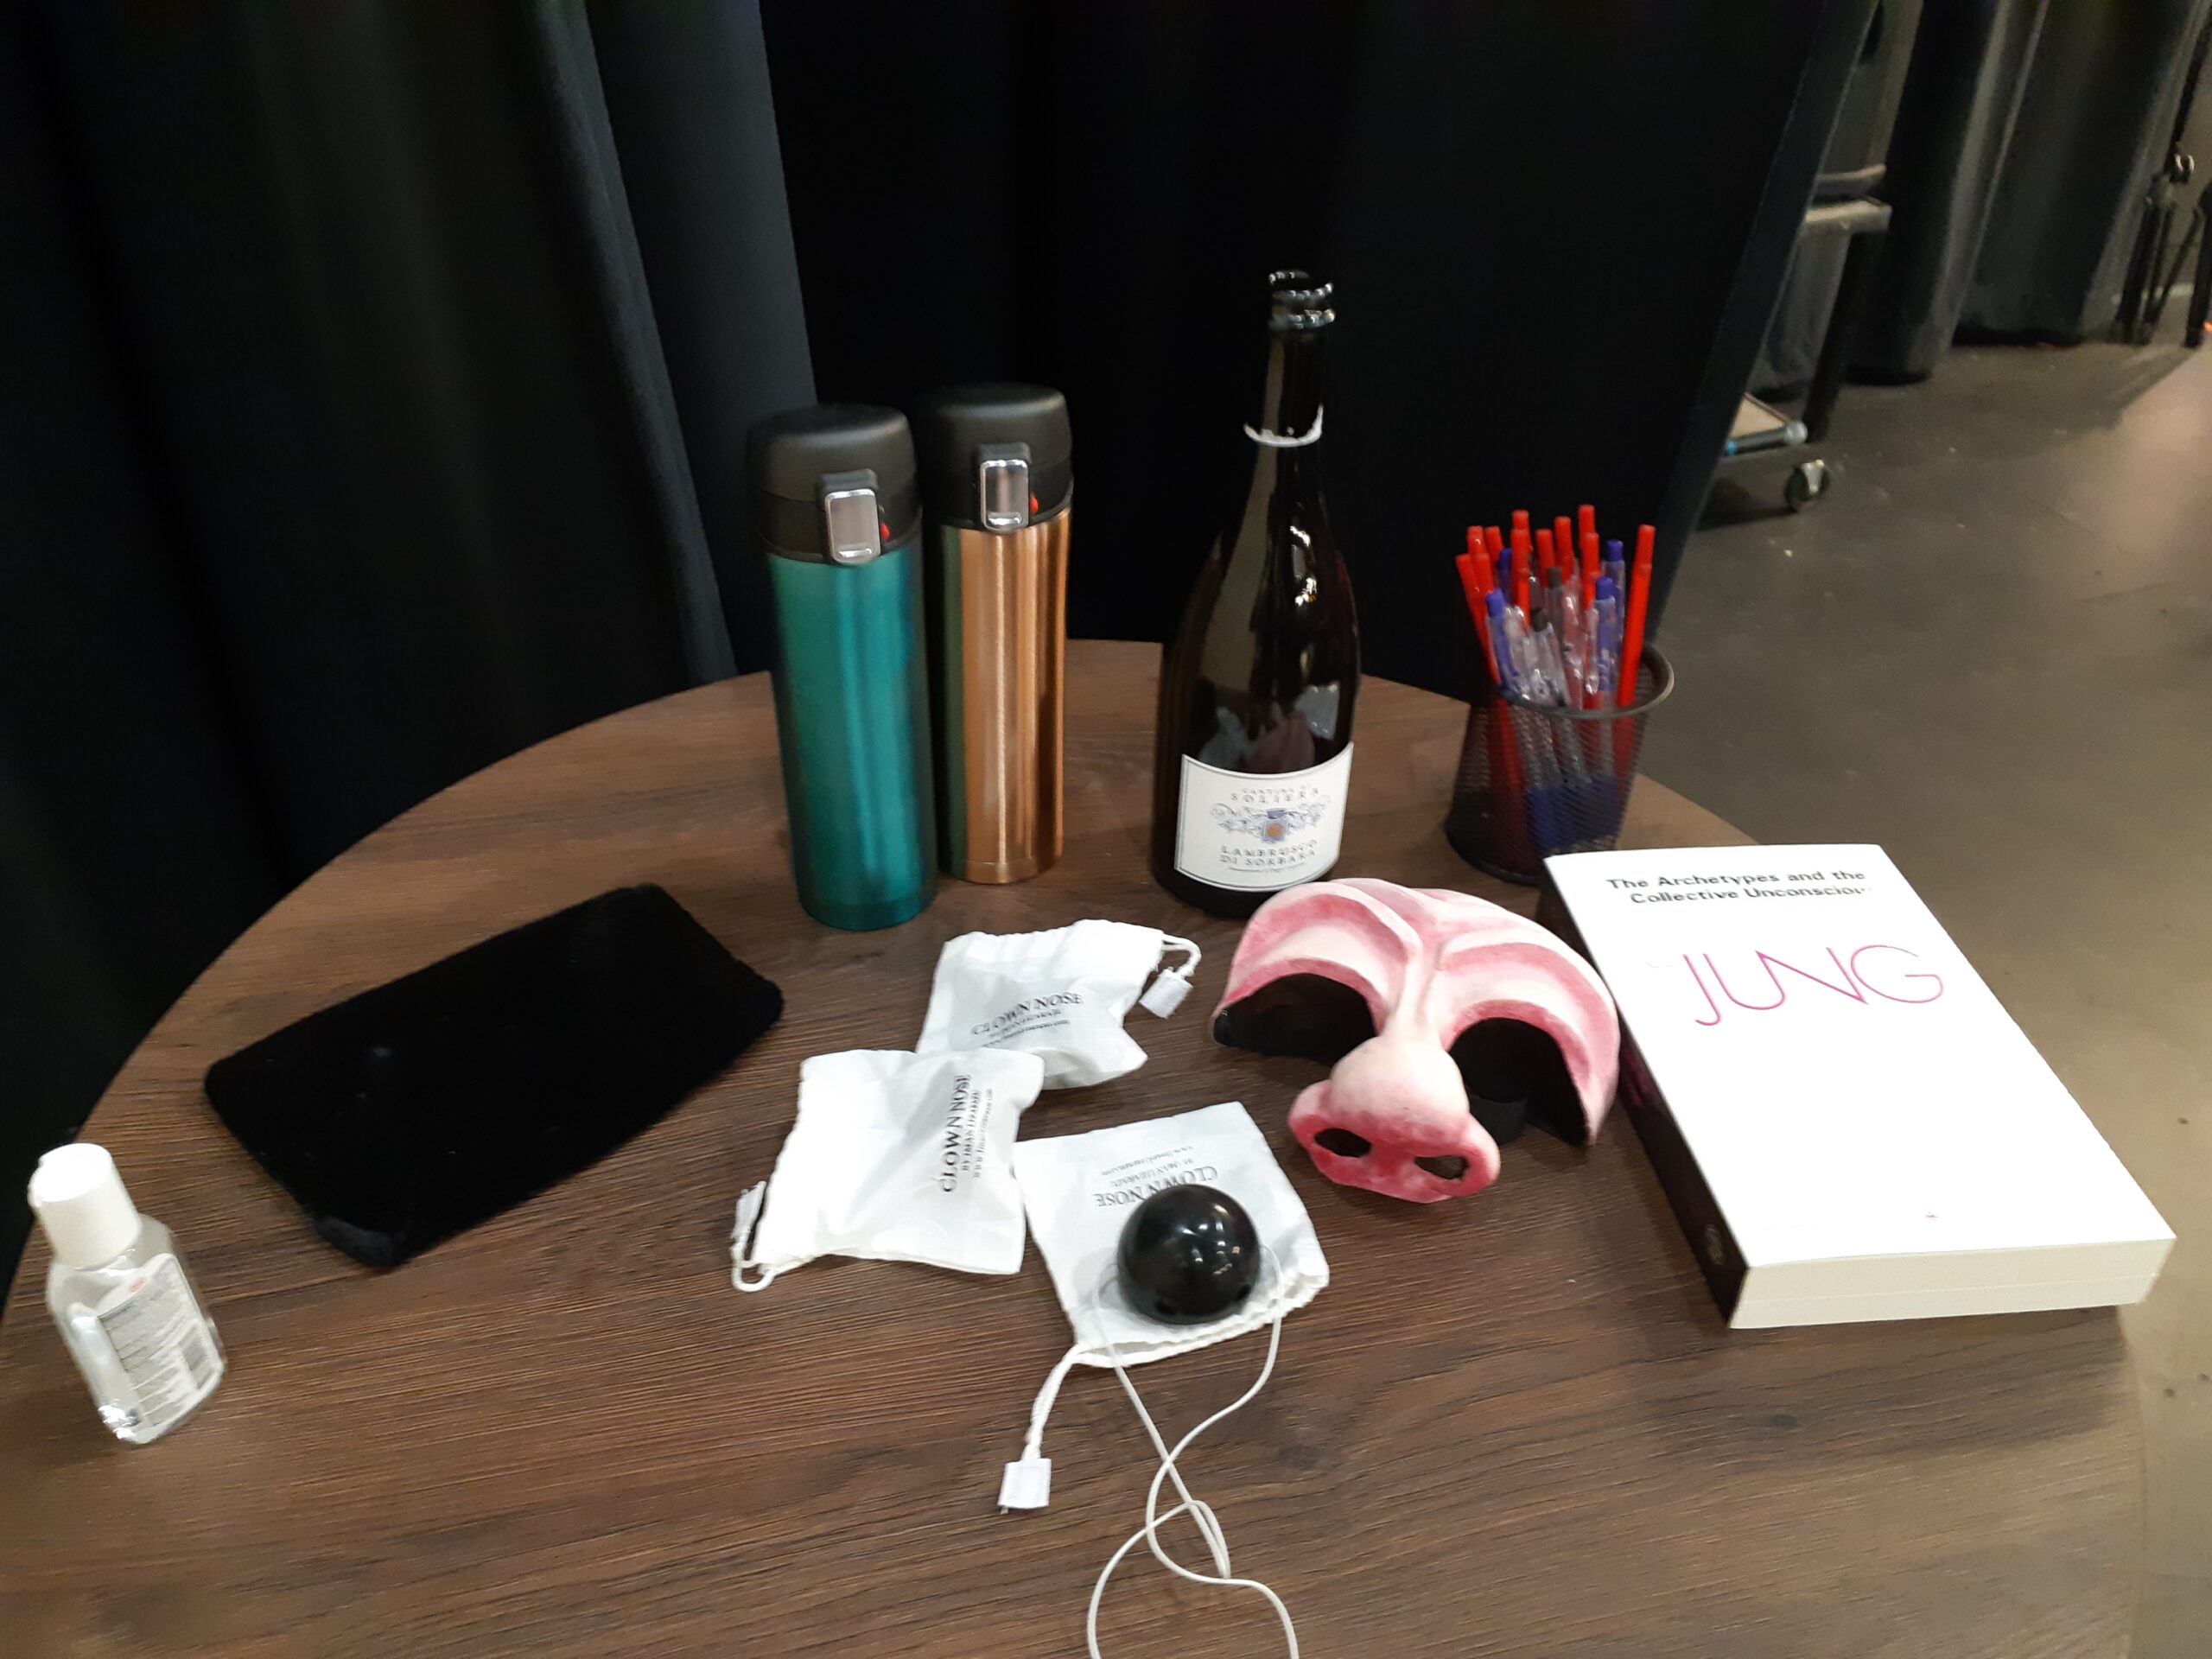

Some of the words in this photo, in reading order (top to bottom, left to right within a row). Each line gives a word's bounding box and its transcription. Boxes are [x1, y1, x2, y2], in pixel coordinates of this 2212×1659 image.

[1605, 879, 1649, 888] The
[1658, 874, 1780, 886] Archetypes
[1787, 871, 1826, 881] and
[1831, 870, 1866, 880] the
[1630, 889, 1738, 903] Collective
[1683, 944, 1944, 1026] JUNG
[969, 1001, 1032, 1035] CLOWN
[1033, 992, 1084, 1010] NOSE
[948, 1074, 971, 1112] NOSE
[938, 1116, 963, 1192] CLOWN
[1093, 1185, 1147, 1207] NOSE
